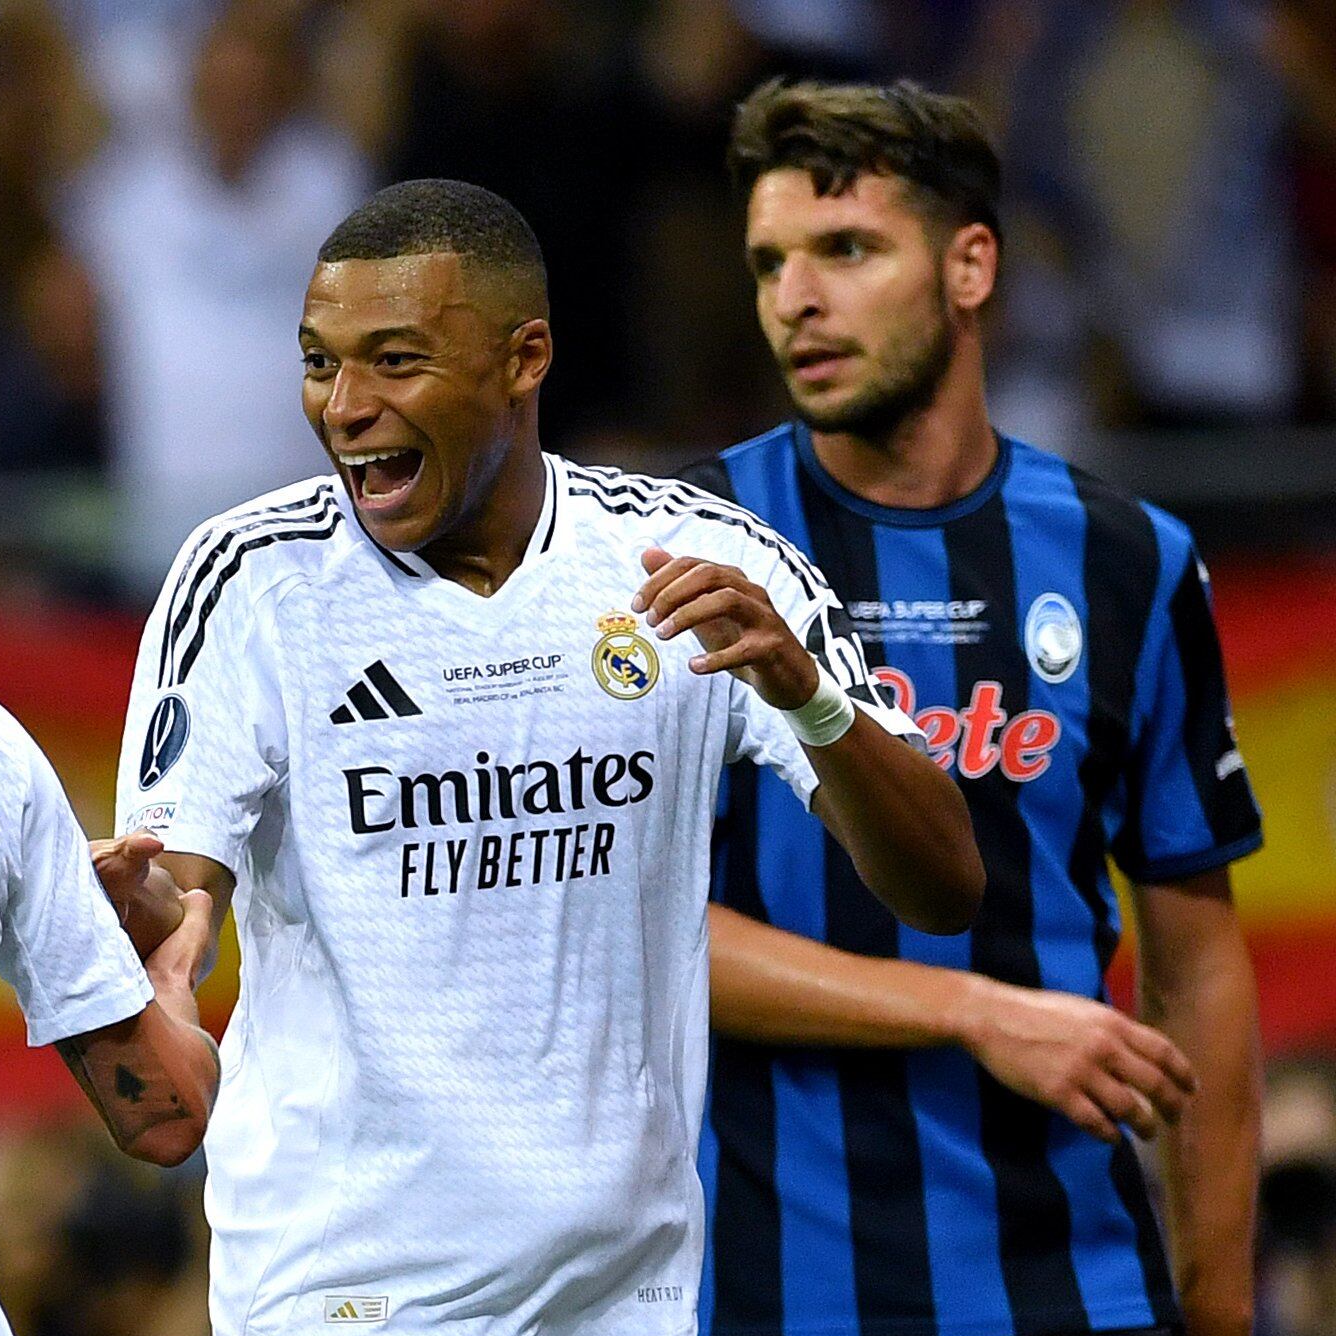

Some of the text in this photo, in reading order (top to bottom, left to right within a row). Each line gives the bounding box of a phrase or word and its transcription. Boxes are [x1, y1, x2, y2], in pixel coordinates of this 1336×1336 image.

[443, 666, 483, 681] UEFA
[485, 658, 531, 678] SUPER
[531, 654, 562, 670] CUP
[341, 746, 655, 835] Emirates
[401, 822, 616, 898] FLY BETTER
